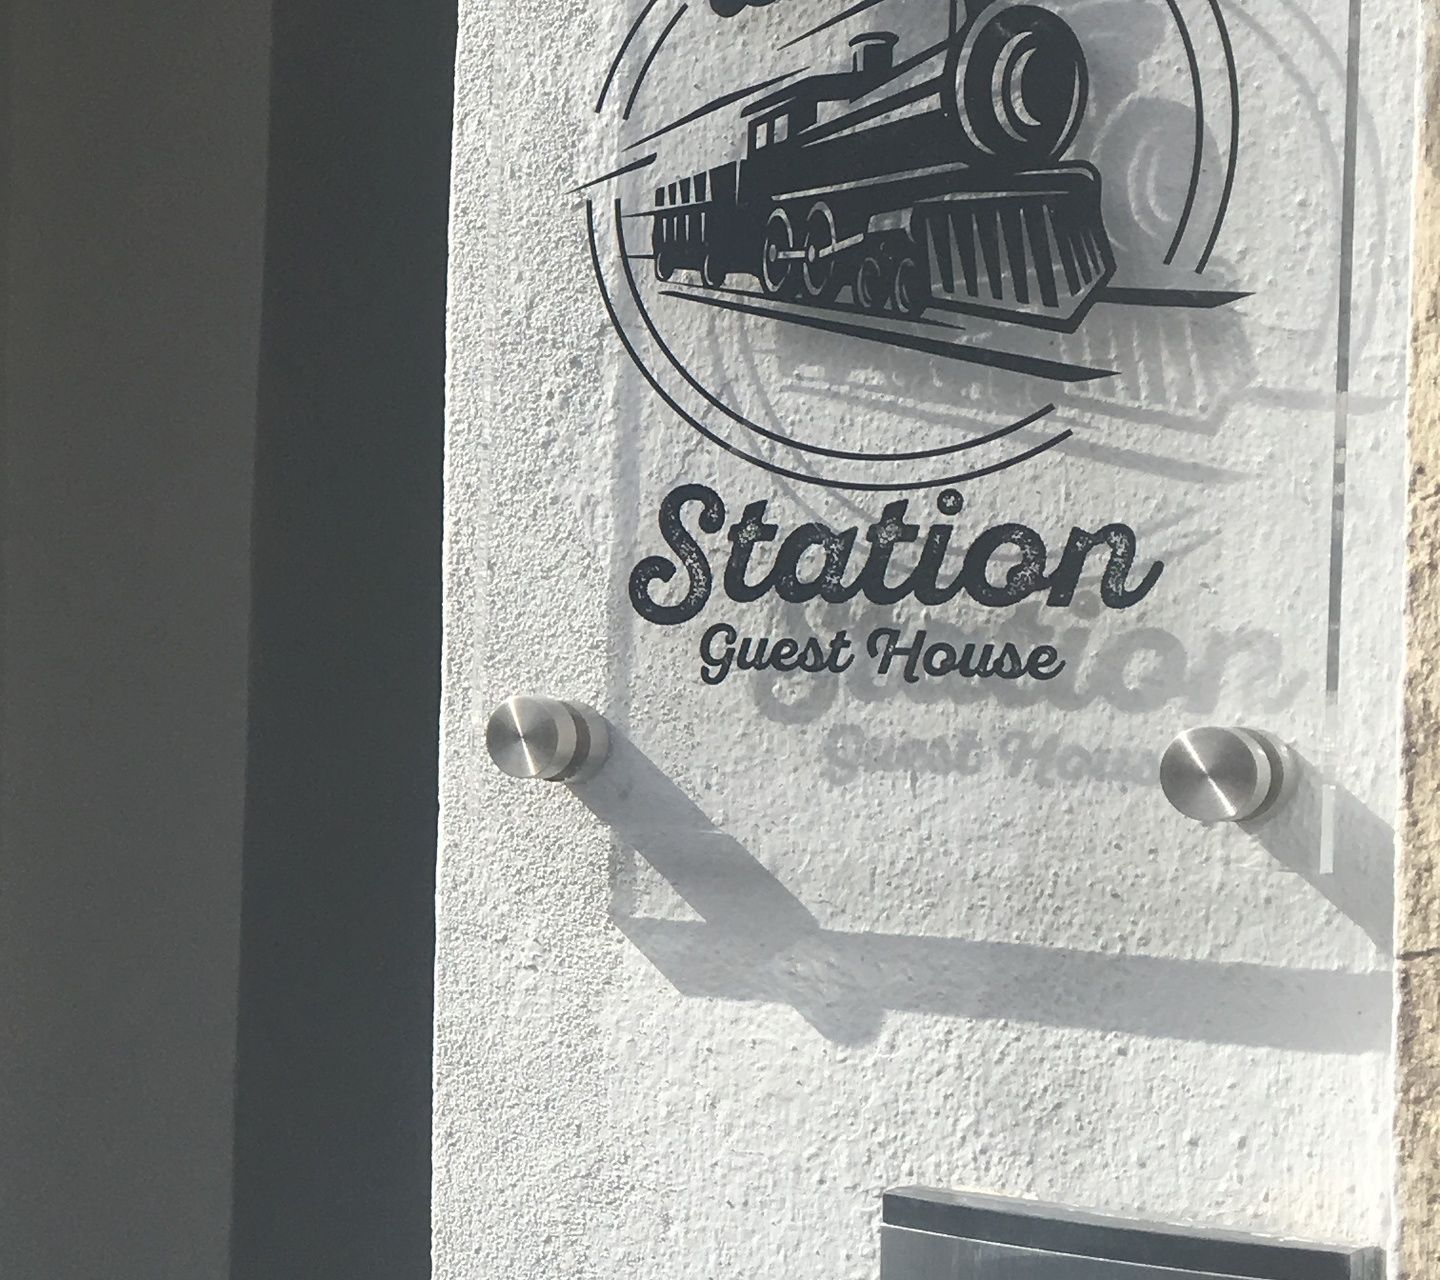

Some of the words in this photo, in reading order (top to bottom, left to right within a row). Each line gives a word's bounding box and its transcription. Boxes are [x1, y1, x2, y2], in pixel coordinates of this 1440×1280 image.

[628, 483, 1165, 626] Station
[699, 622, 855, 686] Guest
[866, 626, 1066, 682] House
